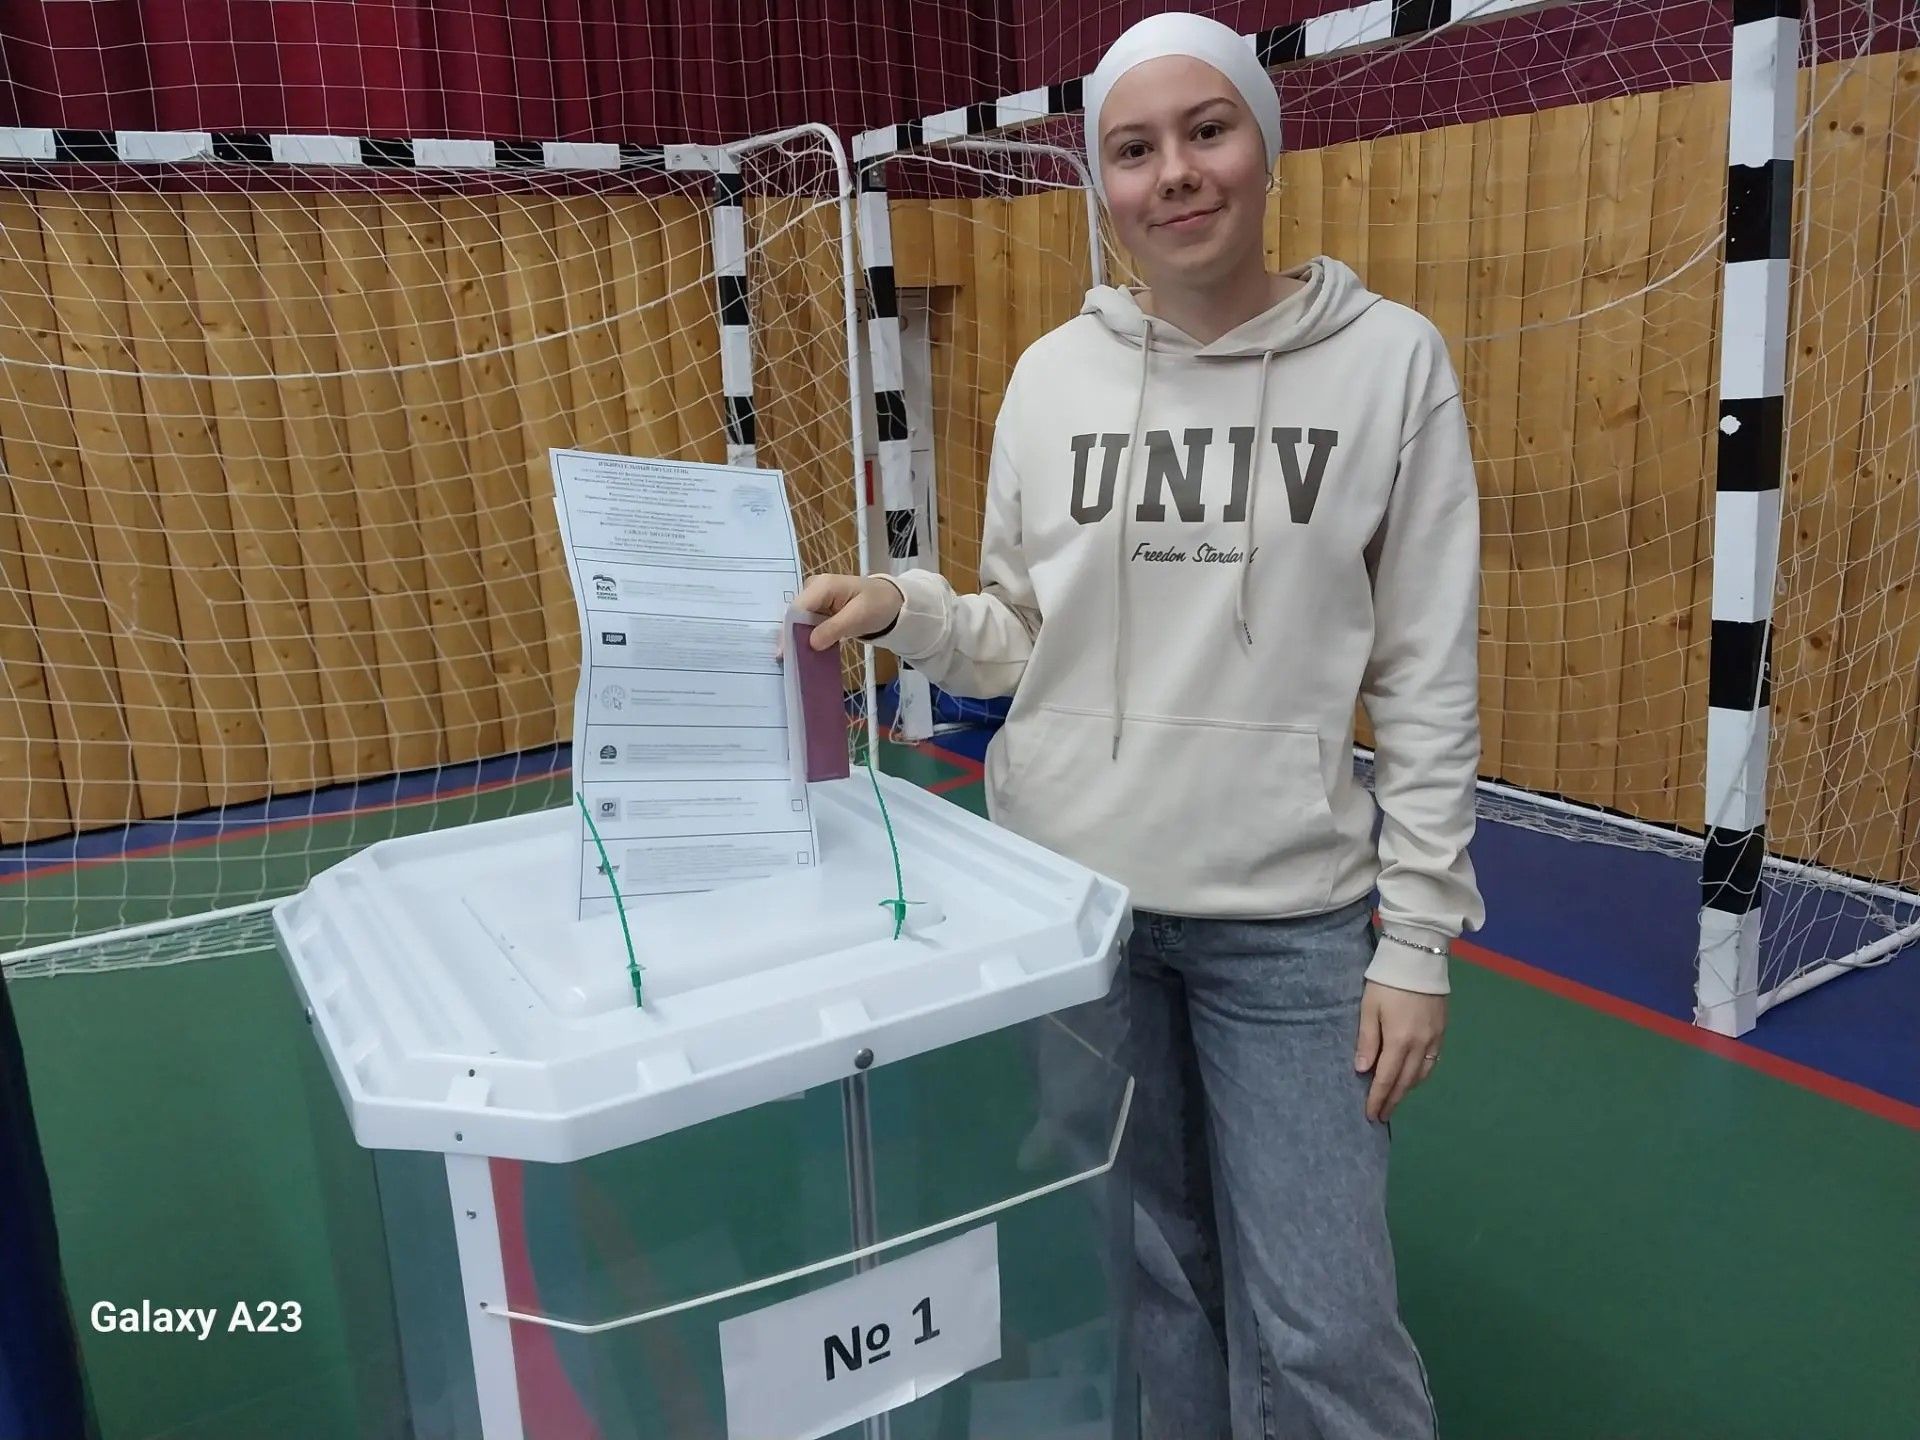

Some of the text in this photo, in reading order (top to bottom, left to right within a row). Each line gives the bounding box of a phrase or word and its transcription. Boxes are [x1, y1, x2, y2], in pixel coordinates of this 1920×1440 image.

[1070, 426, 1338, 526] UNIV
[824, 1296, 940, 1382] № 1
